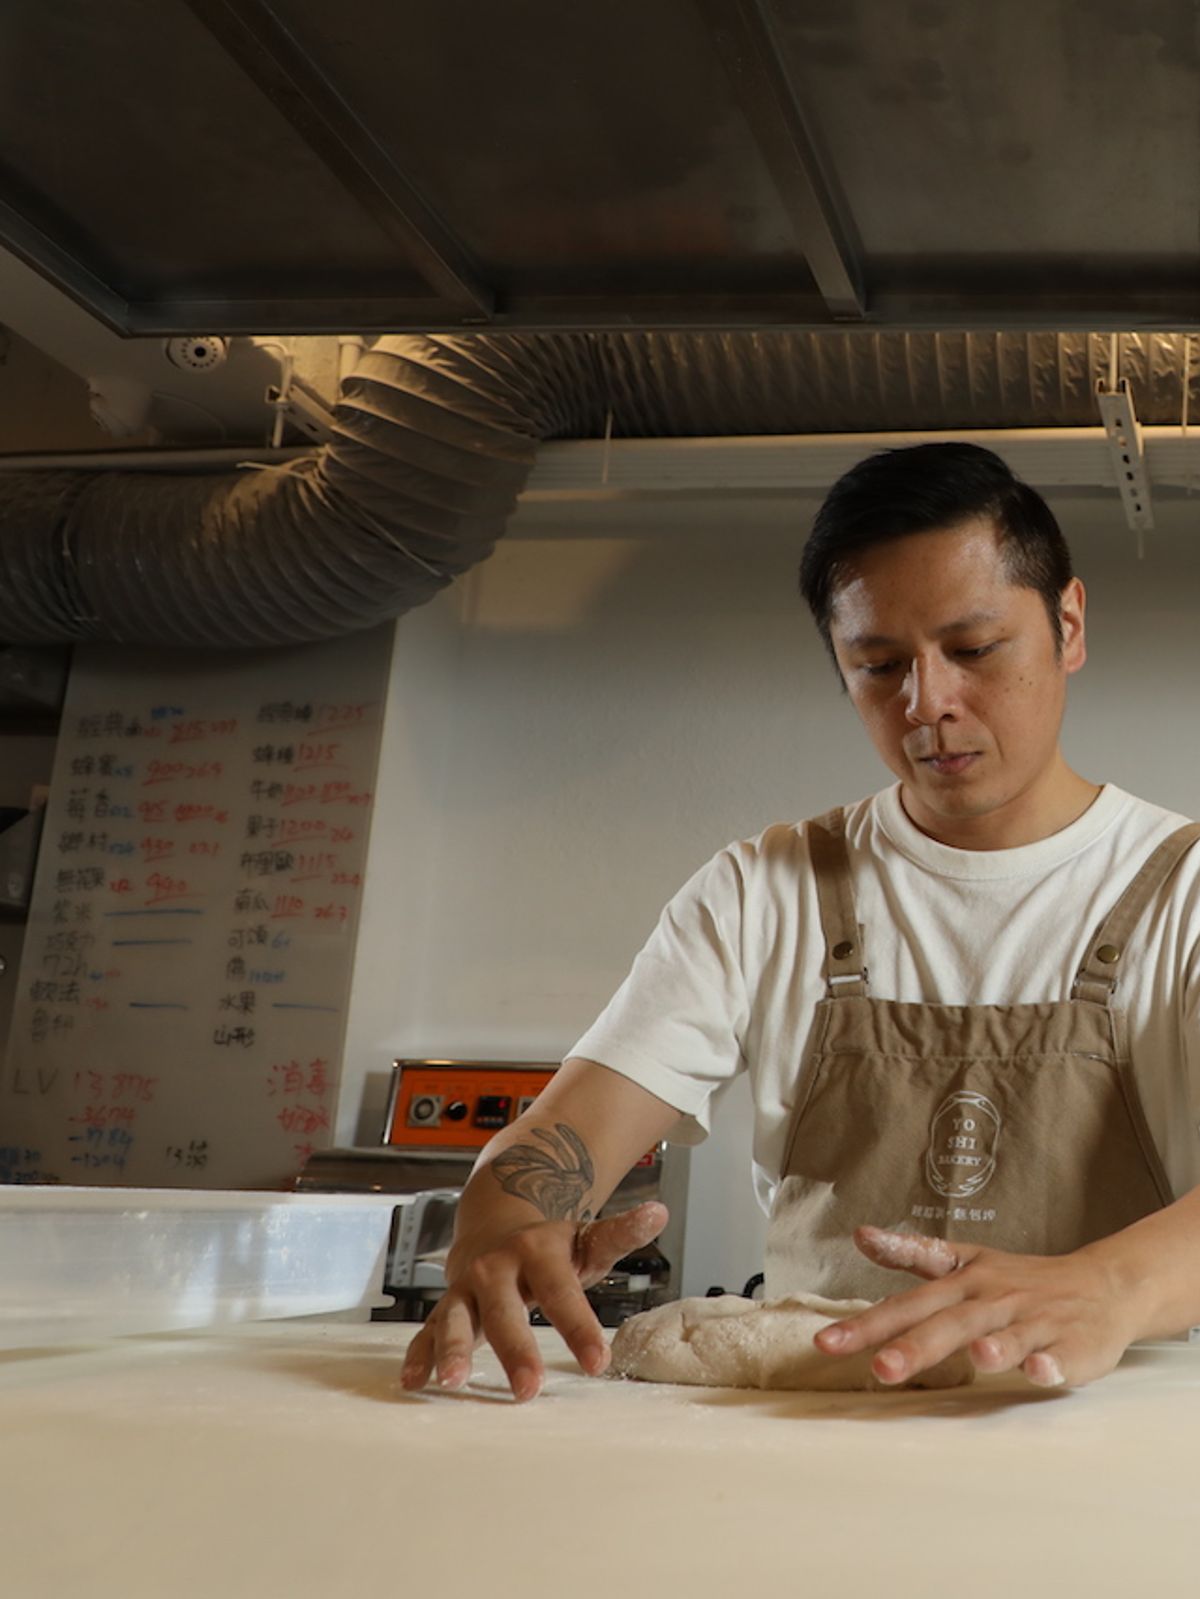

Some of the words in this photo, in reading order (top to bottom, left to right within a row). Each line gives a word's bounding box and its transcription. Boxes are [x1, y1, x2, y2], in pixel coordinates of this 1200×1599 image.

[218, 990, 256, 1016] 水果
[267, 1058, 330, 1097] 消毒
[953, 1118, 976, 1132] YO
[948, 1136, 977, 1149] SHI
